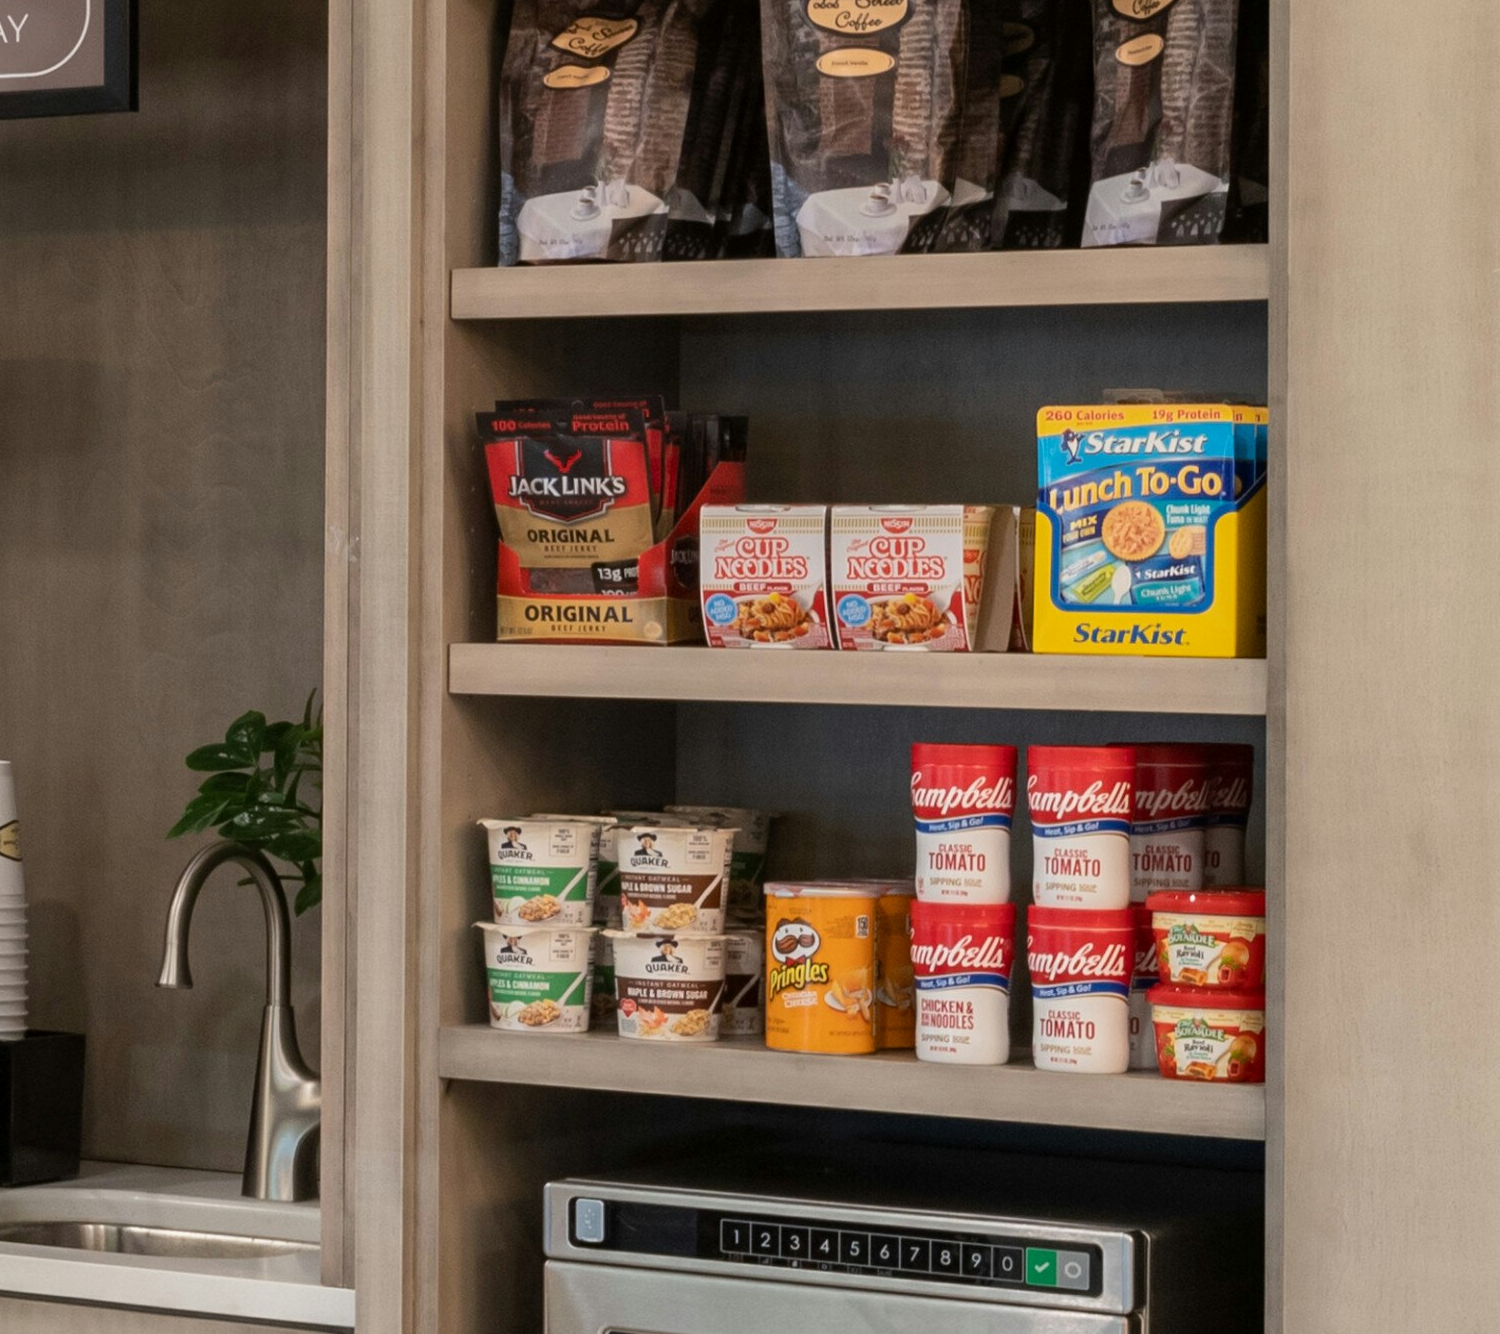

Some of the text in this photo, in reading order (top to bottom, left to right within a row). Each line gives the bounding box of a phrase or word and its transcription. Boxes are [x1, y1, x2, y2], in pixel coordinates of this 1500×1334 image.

[835, 13, 882, 32] Coffee
[1045, 410, 1124, 421] 260 Calories
[1152, 409, 1221, 422] 19g Protein
[492, 420, 516, 431] 100
[572, 419, 629, 432] Protein
[1085, 430, 1208, 455] StarKist
[509, 475, 626, 496] JACK LINK'S
[1048, 470, 1132, 515] Lunch
[527, 528, 615, 543] ORIGINAL
[735, 536, 789, 558] CUP
[869, 536, 925, 558] CUP
[598, 568, 622, 582] 13g
[715, 556, 808, 580] NOODLES
[847, 556, 945, 580] NOODLES
[1144, 563, 1197, 579] StarKist
[739, 583, 767, 591] BEEF
[873, 583, 901, 591] BEEF
[524, 605, 633, 623] ORIGINAL
[551, 624, 606, 633] BEEF JERKY
[1073, 622, 1186, 646] StarKist
[497, 850, 533, 861] QUAKER
[938, 843, 973, 853] CLASSIC
[1054, 848, 1088, 858] CLASSIC
[630, 857, 669, 868] QUAKER
[928, 852, 986, 872] TOMATO
[1044, 856, 1101, 877] TOMATO
[1133, 853, 1192, 873] TOMATO
[667, 883, 692, 894] SUGAR
[496, 953, 533, 966] QUAKER
[1176, 949, 1204, 959] Ravioli
[645, 963, 689, 975] QUAKER
[770, 958, 829, 1002] Pringles
[921, 998, 964, 1013] CHICKEN
[931, 1015, 974, 1030] NOODLES
[1048, 1010, 1081, 1020] CLASSIC
[1040, 1018, 1095, 1040] TOMATO
[1183, 1043, 1214, 1054] Ravioli
[733, 1229, 1013, 1272] 1 2 3 4 5 6 7 8 9 0
